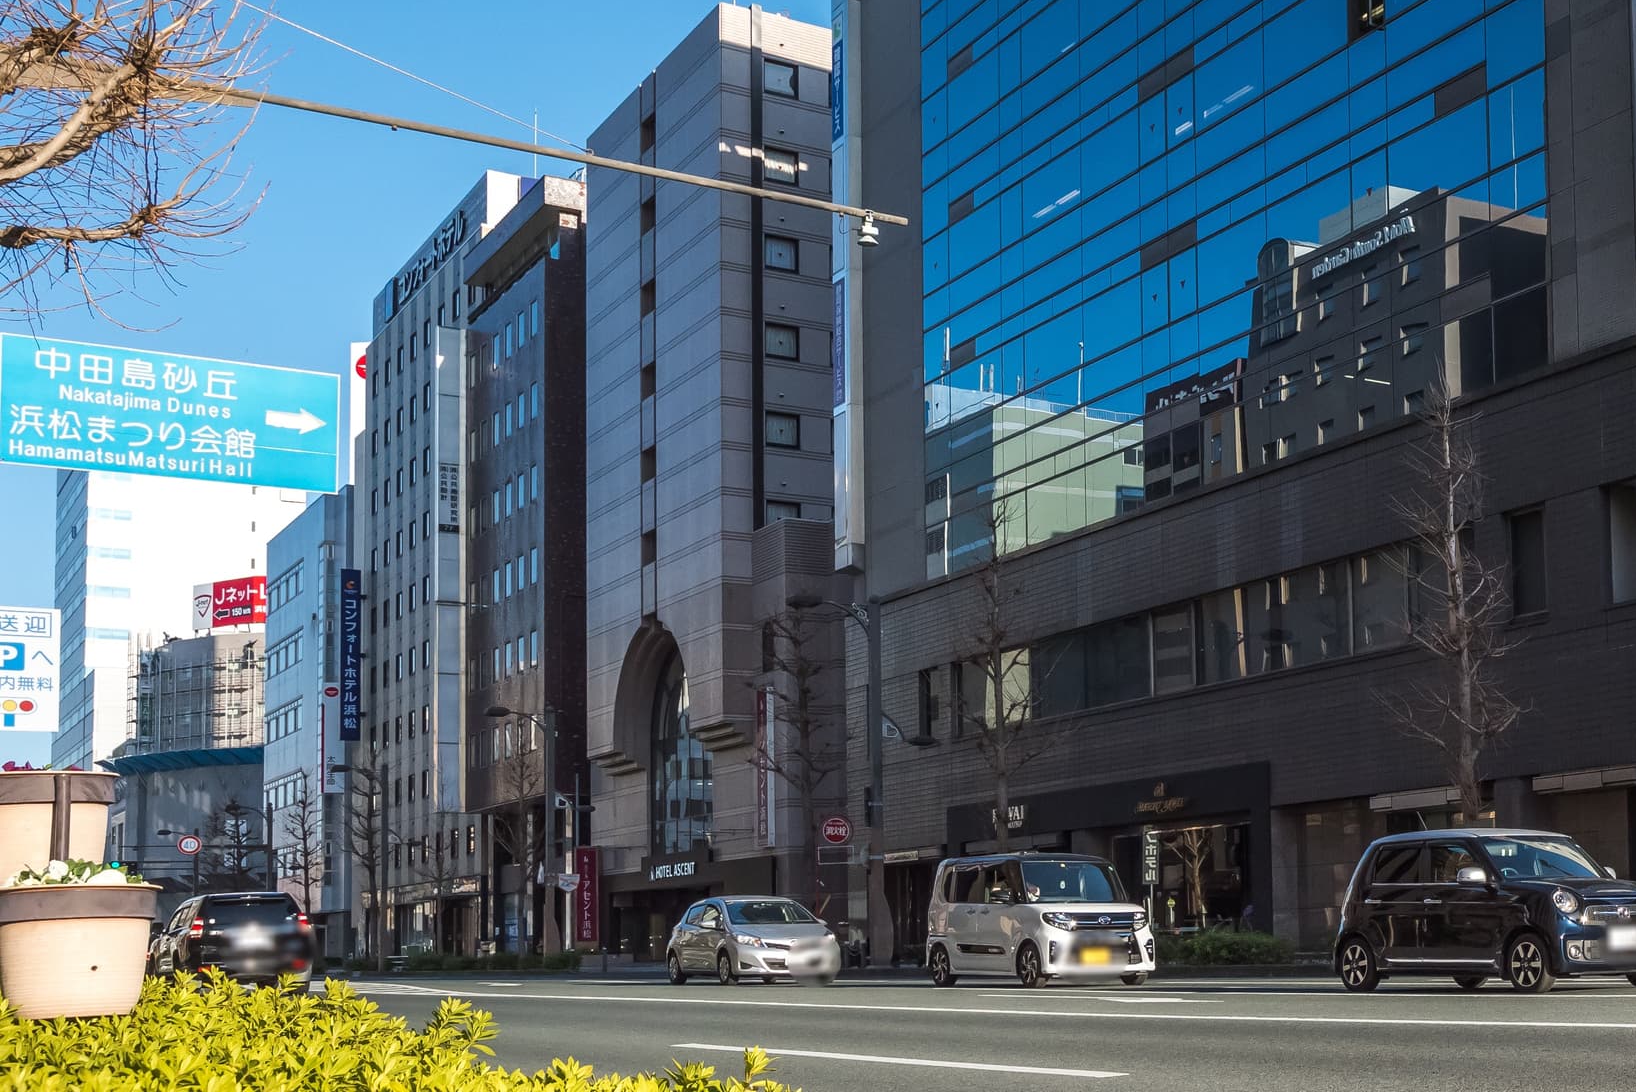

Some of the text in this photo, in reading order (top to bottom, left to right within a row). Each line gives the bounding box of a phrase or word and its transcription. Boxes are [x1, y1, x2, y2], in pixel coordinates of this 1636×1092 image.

[35, 346, 239, 401] 中田島砂丘
[59, 384, 231, 420] Nakatajima Dunes
[9, 403, 256, 459] 浜松まつり会館
[8, 438, 253, 478] Hamamatsu Matsuri Hall
[343, 599, 357, 729] コンフォートホテル浜松
[183, 840, 196, 849] 40
[825, 825, 847, 836] 消火栓
[655, 861, 696, 879] HOTEL ASCENT
